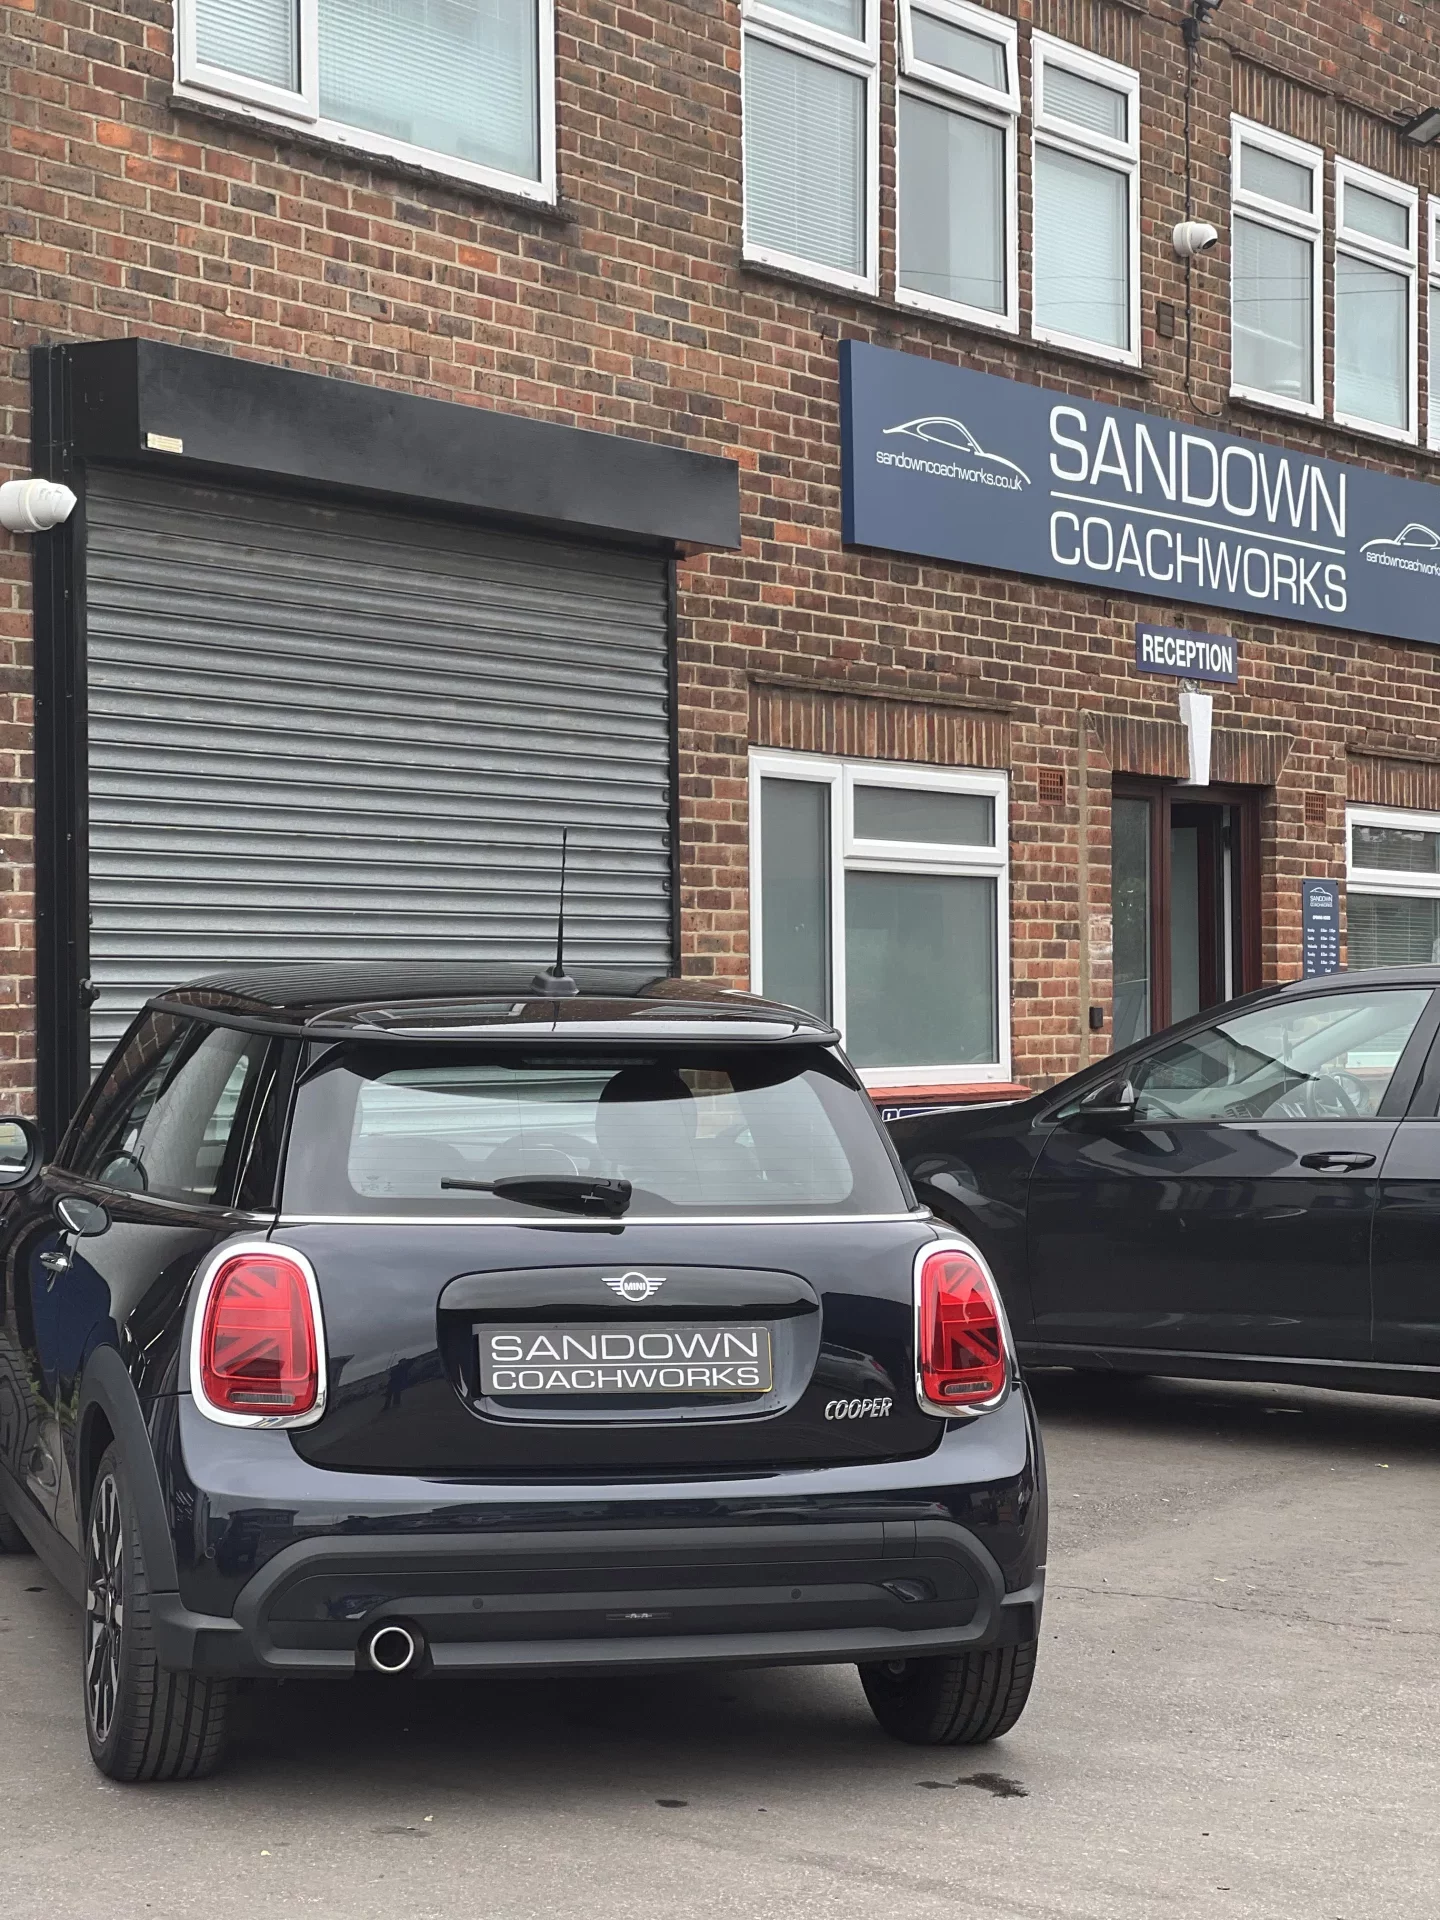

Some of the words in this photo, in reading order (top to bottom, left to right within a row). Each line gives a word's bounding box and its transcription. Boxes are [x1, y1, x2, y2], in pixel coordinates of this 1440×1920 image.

[876, 451, 1023, 491] sandowncoachworks.co.uk
[1050, 405, 1346, 538] SANDOWN
[1050, 510, 1347, 612] COACHWORKS
[1142, 633, 1233, 674] RECEPTION
[624, 1282, 646, 1291] MINI
[491, 1332, 758, 1361] SANDOWN
[492, 1367, 760, 1390] COACHWORKS
[824, 1397, 893, 1421] COOPER
